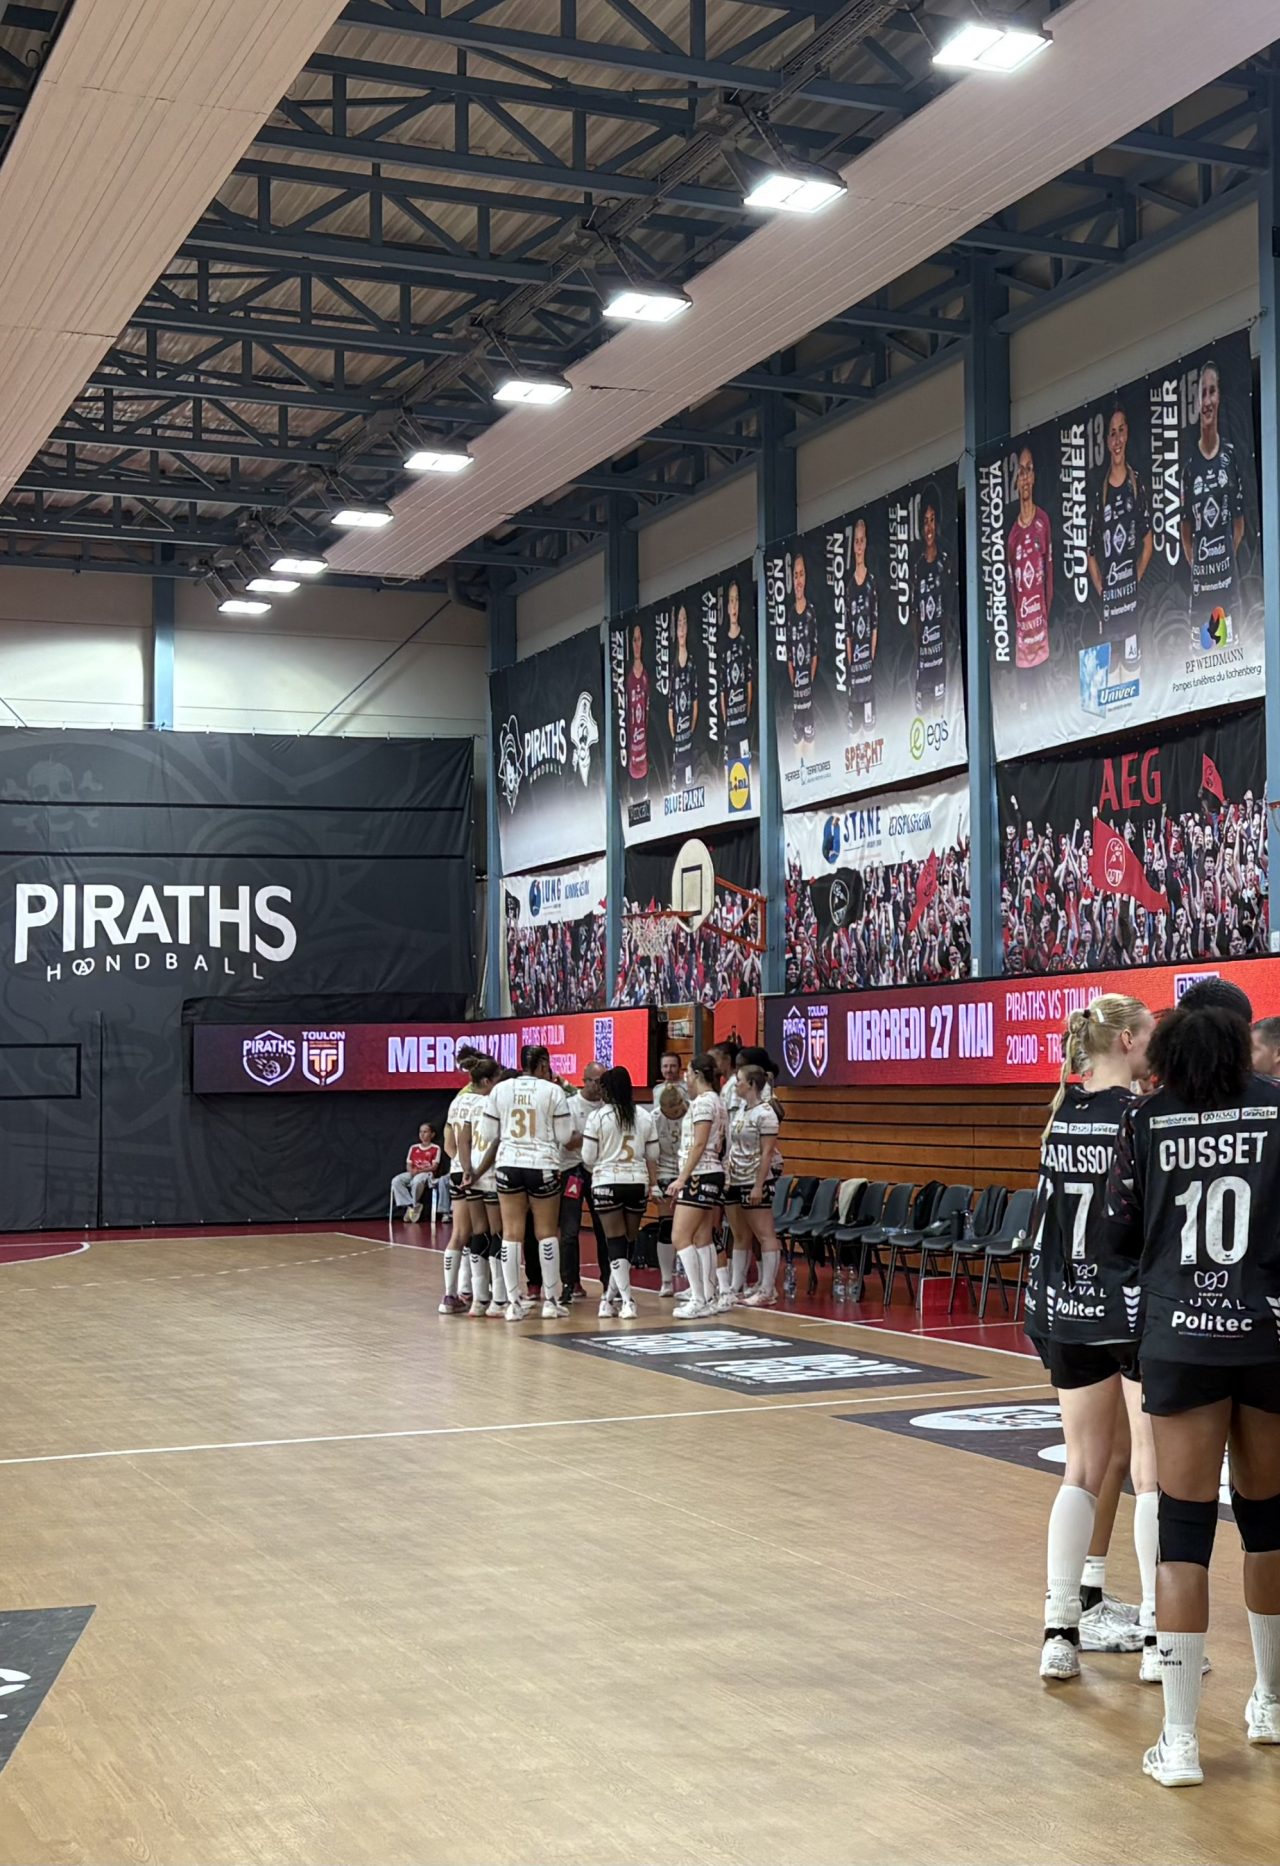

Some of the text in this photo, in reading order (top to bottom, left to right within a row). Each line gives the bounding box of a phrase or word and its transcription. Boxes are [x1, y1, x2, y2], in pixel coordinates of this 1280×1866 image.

[1087, 413, 1105, 470] 13
[1150, 387, 1166, 553] CORENTINE
[1004, 452, 1020, 505] 12
[1162, 378, 1181, 566] CAVALIER
[1071, 423, 1089, 604] GUERRIER
[897, 503, 910, 625] CUSSET
[773, 558, 787, 662] BEGON
[833, 532, 847, 692] KARLSSON
[660, 612, 670, 696] CLERC
[708, 593, 718, 741] MAUFFREY
[1101, 684, 1136, 704] Univer
[525, 718, 567, 777] PIRATHS
[664, 792, 683, 816] BLUE
[683, 786, 704, 813] PARK
[1100, 747, 1161, 813] AEG
[14, 883, 297, 964] PIRATHS
[847, 1002, 994, 1061] MERCREDI 27 MAI
[1006, 986, 1102, 1021] PIRATHS VS TOUL
[243, 1039, 296, 1055] PIRATHS
[302, 1031, 345, 1040] TOULON
[1006, 1034, 1038, 1064] 20H00
[510, 1108, 537, 1139] 31
[619, 1135, 635, 1163] 5
[1159, 1131, 1268, 1172] CUSSET
[1174, 1175, 1251, 1265] 10
[1056, 1298, 1105, 1317] Politec
[1171, 1310, 1253, 1332] Politec
